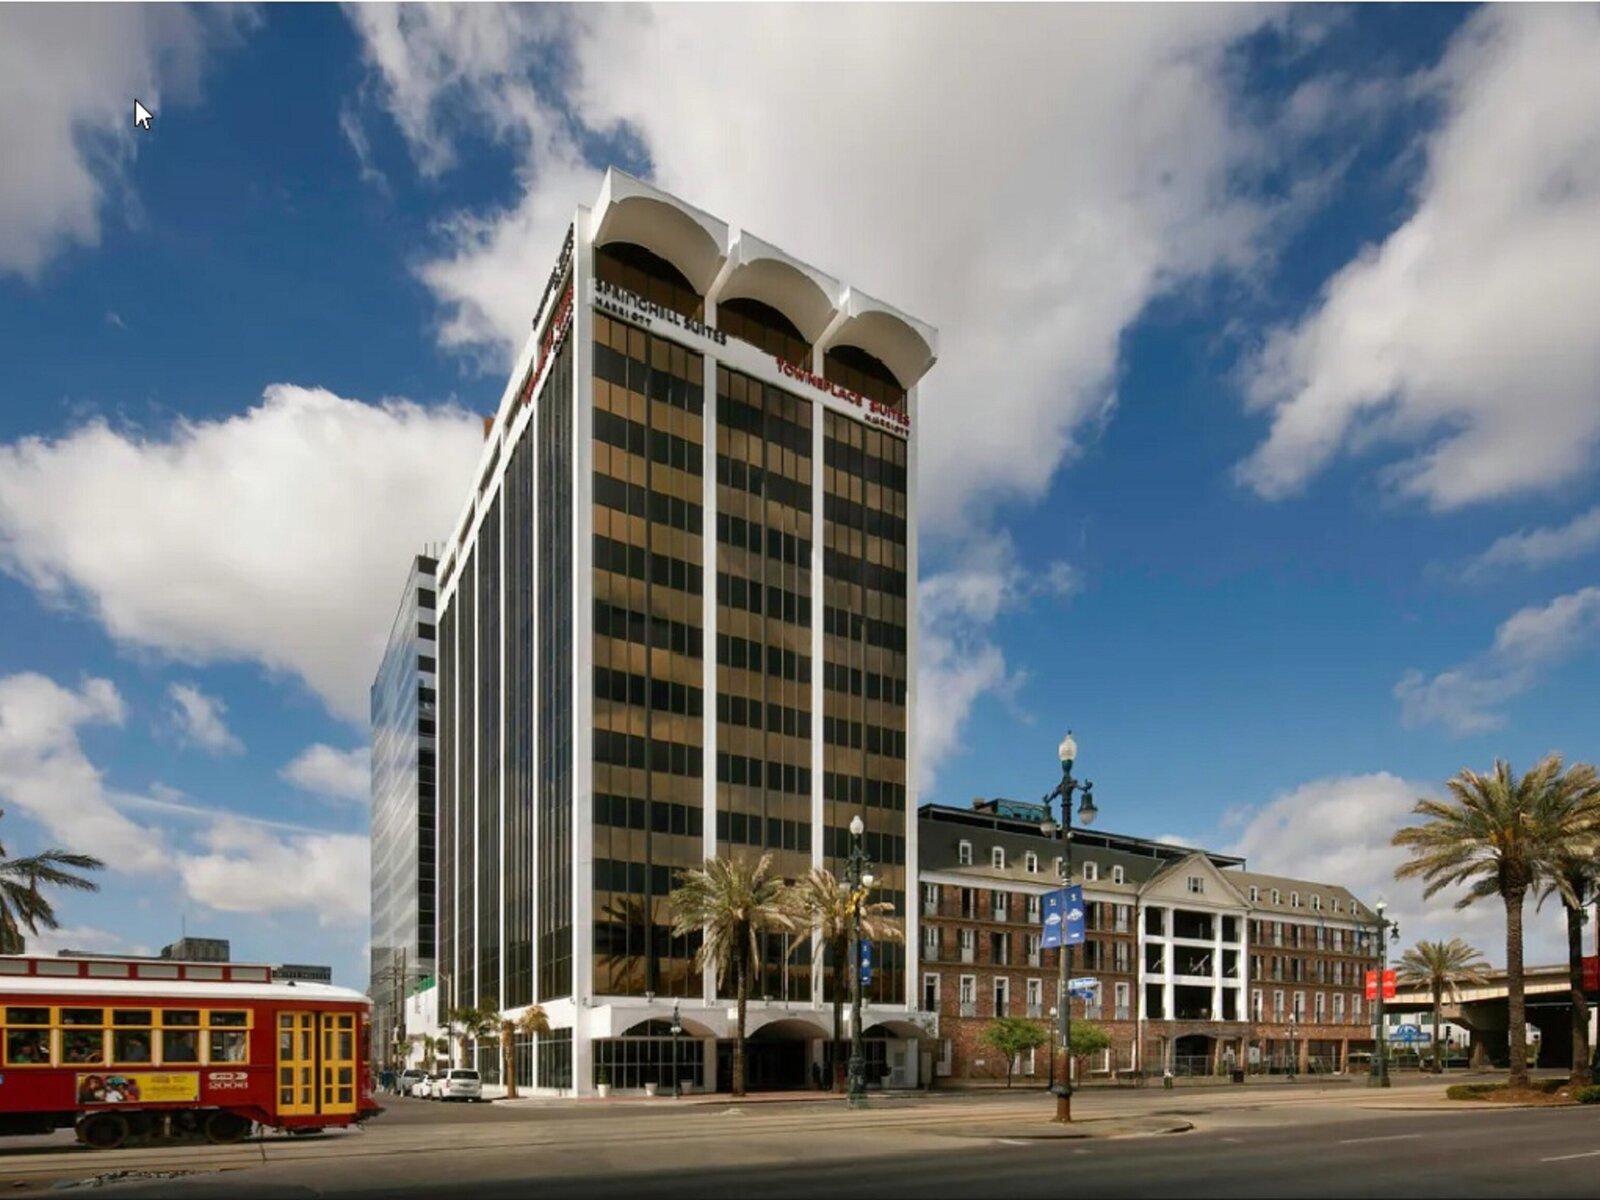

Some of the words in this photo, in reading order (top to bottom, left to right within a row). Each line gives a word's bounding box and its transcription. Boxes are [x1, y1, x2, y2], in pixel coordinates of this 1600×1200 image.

[594, 295, 653, 327] MARRIOTT
[594, 278, 682, 328] SPRINGHILL
[683, 314, 728, 347] SUITES
[776, 355, 864, 409] TOWNEPLACE
[869, 399, 911, 427] SUITES
